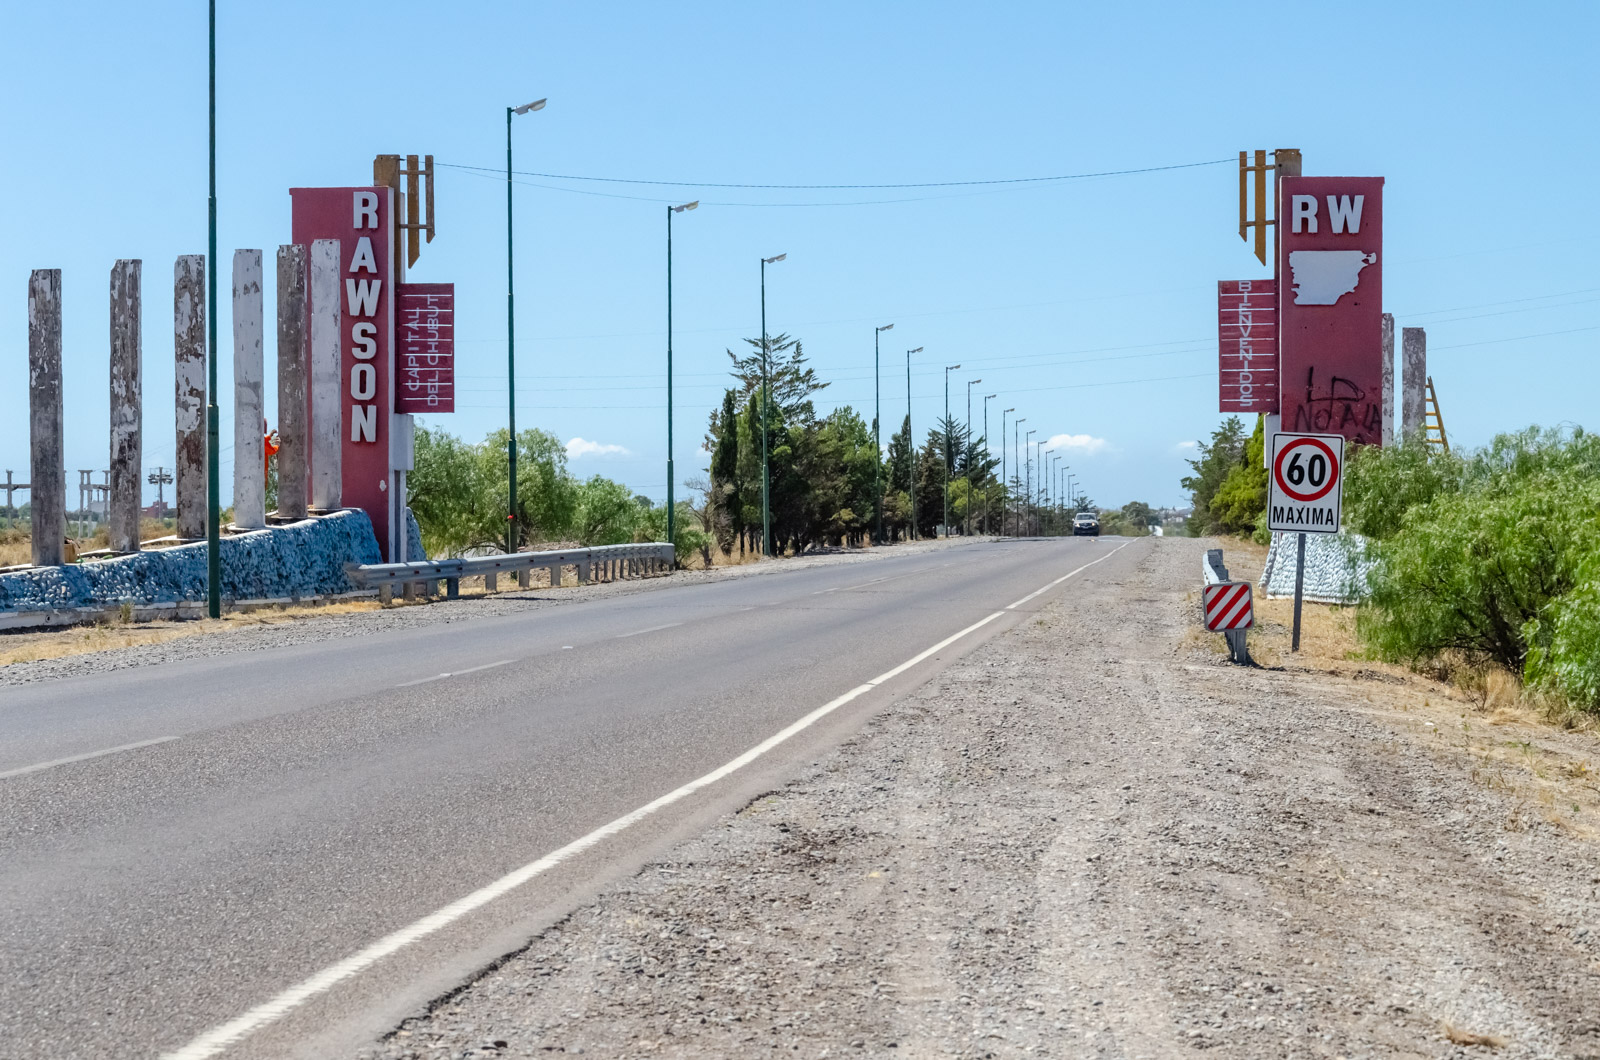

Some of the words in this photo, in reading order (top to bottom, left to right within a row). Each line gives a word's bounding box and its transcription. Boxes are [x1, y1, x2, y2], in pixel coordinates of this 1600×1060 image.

[1291, 194, 1365, 234] RW
[345, 190, 382, 443] RAWSON
[427, 294, 439, 366] CHUBUT
[1238, 280, 1253, 407] BIENVENIDOS
[408, 307, 419, 391] CAPITAL
[427, 370, 439, 406] DEL
[1286, 452, 1326, 487] 60
[1272, 505, 1334, 526] MAXIMA
